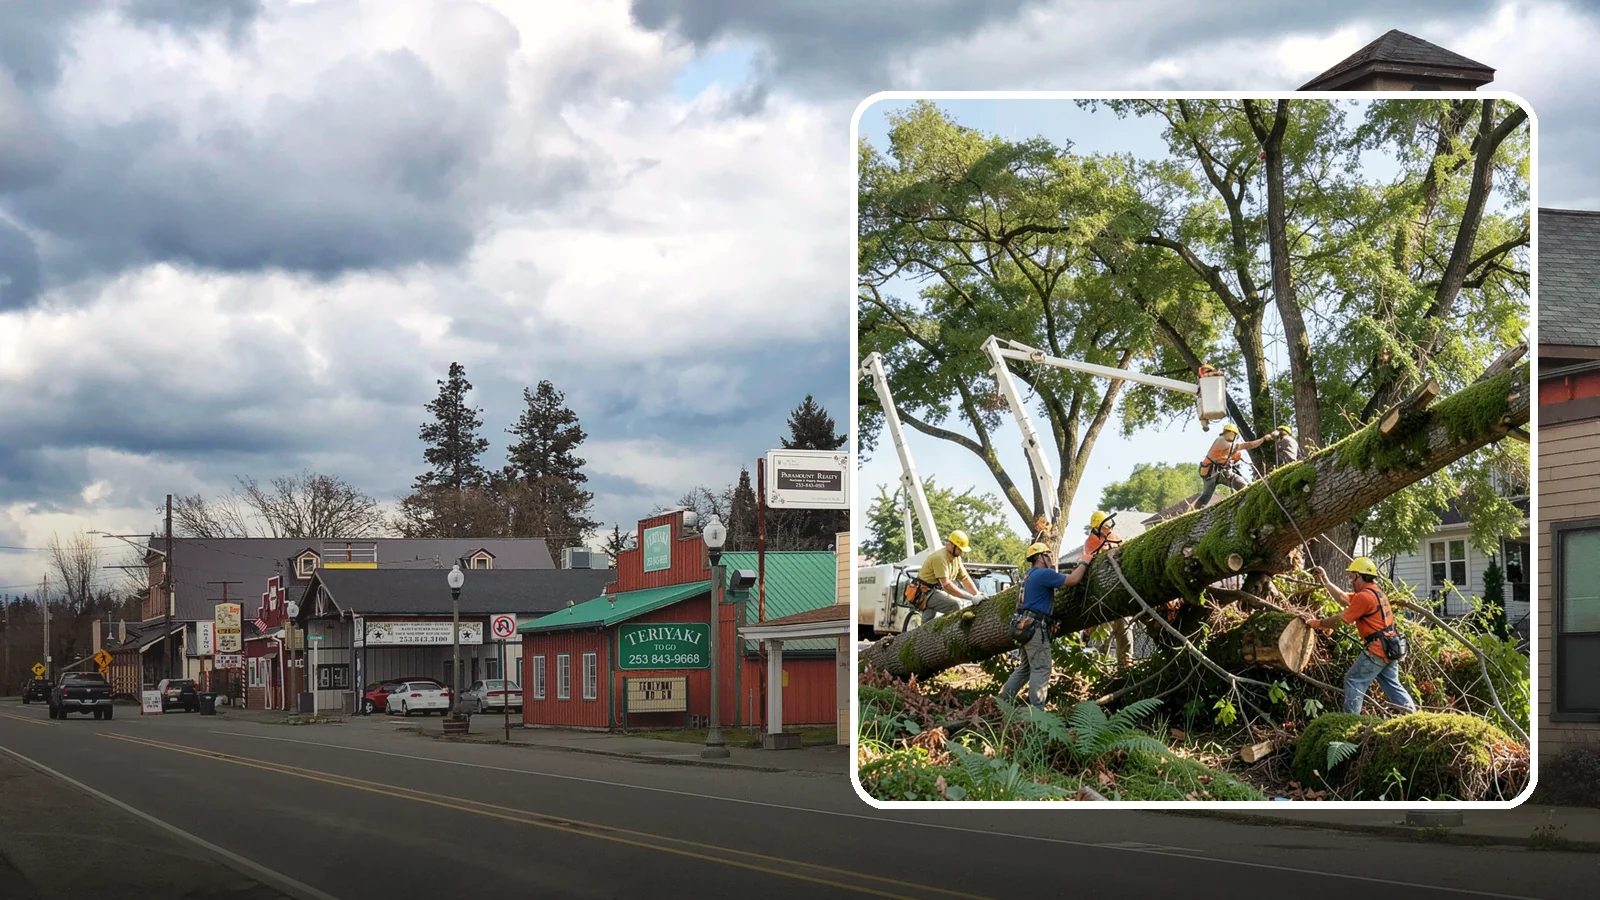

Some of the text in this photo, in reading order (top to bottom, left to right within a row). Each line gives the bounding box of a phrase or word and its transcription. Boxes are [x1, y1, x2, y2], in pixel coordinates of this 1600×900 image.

[625, 627, 702, 645] TERIYAKI
[629, 654, 700, 664] 253 843-9668
[639, 681, 672, 691] TERIYAKI
